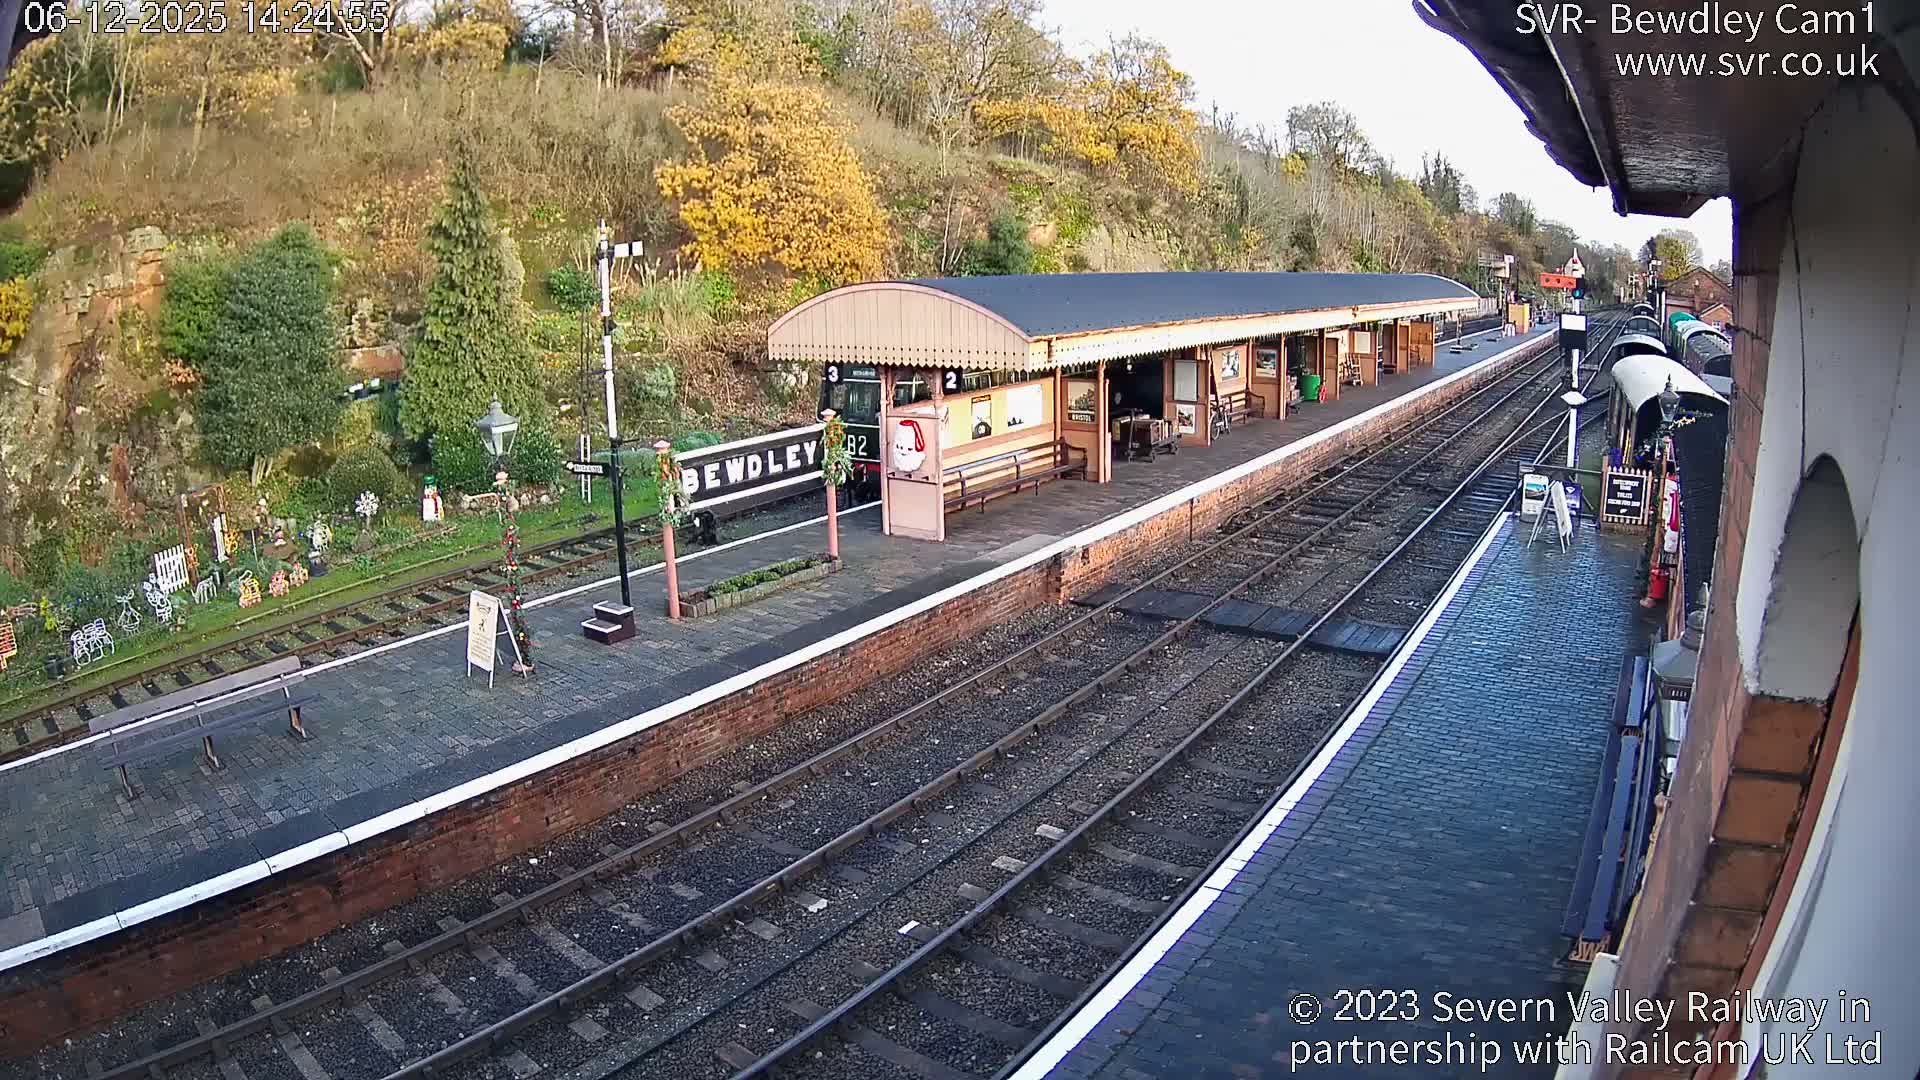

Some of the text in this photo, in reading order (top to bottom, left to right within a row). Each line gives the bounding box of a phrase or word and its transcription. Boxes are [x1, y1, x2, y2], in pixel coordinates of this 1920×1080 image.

[827, 365, 839, 382] 3
[945, 371, 957, 389] 2
[680, 440, 817, 495] BEWDLEY
